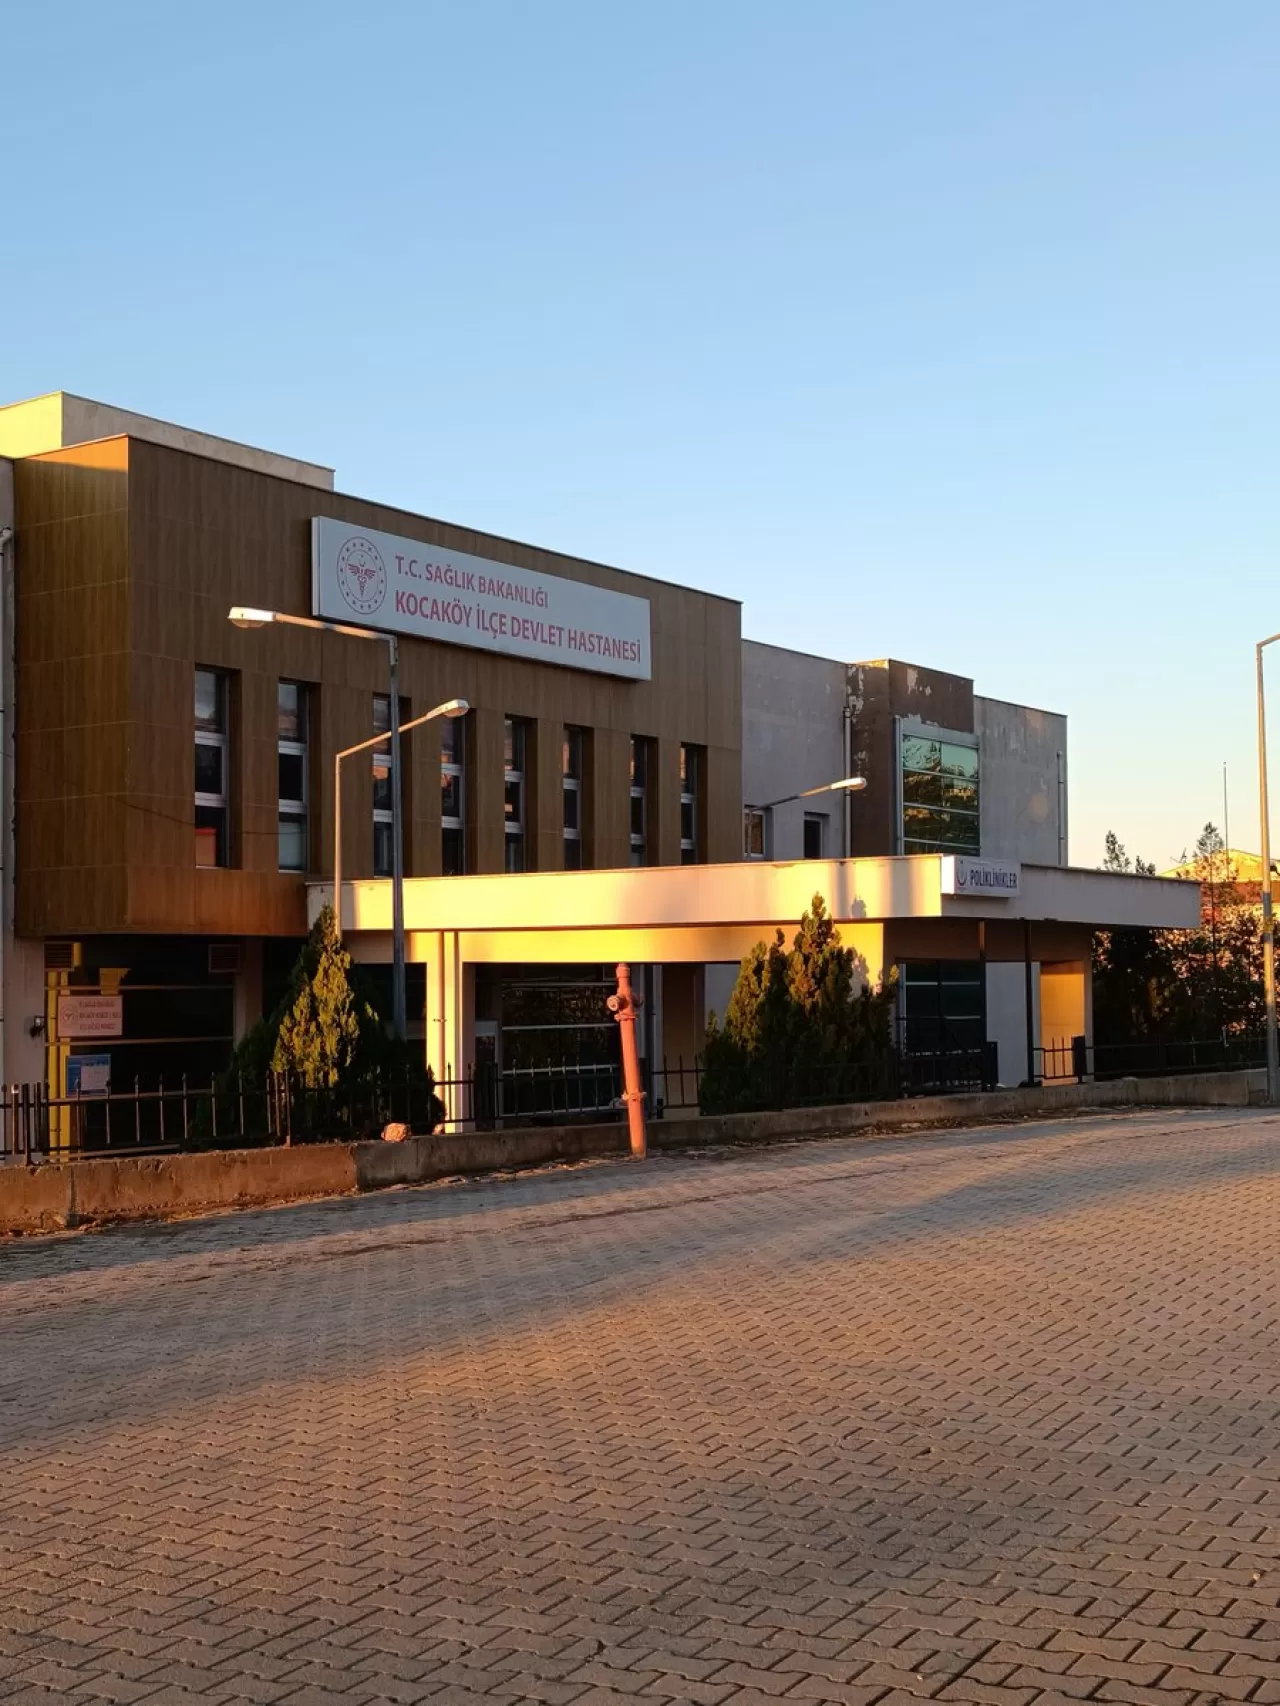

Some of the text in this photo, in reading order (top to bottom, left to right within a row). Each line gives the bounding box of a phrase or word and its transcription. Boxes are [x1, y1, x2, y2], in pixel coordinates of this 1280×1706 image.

[395, 554, 548, 609] T.C. SAĞLIK BAKANLIĞI
[395, 590, 641, 663] KOCAKÖY İLÇE DEVLET HASTANESİ
